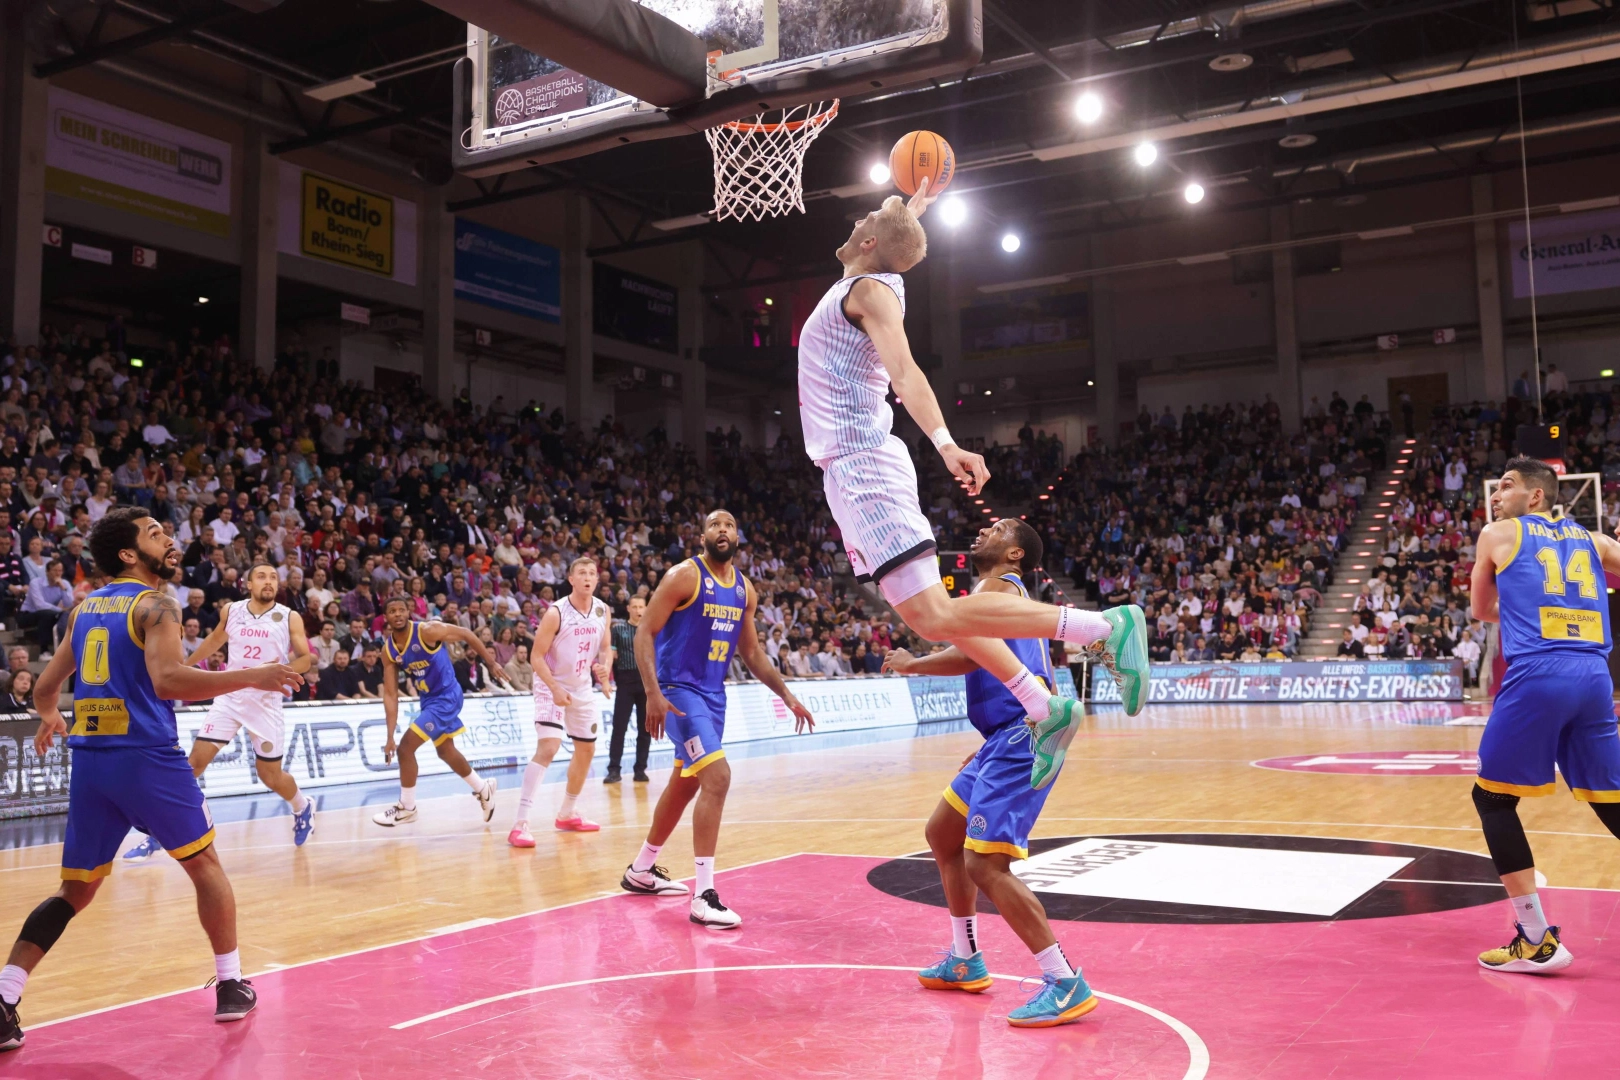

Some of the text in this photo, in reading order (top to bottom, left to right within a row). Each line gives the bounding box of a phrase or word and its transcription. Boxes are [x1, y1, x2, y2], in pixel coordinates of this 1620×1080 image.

[525, 77, 577, 97] BASKETBALL
[525, 83, 584, 106] CHAMPIONS
[525, 100, 560, 115] LEAGUE
[60, 116, 97, 142] MEIN
[101, 129, 178, 166] SCHREINER
[180, 152, 219, 181] WERK
[919, 152, 927, 167] FIBA
[937, 141, 951, 184] Wilson
[316, 186, 382, 226] Radio
[48, 228, 60, 244] C
[327, 217, 370, 242] Bonn/
[134, 248, 145, 265] B
[312, 231, 384, 267] Rhein-Sieg
[1549, 425, 1560, 439] 9
[956, 553, 966, 569] 2
[1535, 546, 1599, 600] 14
[711, 619, 735, 632] bwin
[1546, 612, 1597, 623] PIRAEUS BANK
[240, 628, 269, 638] BONN
[574, 627, 597, 636] BONN
[243, 645, 262, 660] 22
[577, 641, 591, 654] 54
[708, 639, 730, 662] 32
[81, 627, 110, 685] 0
[1261, 665, 1283, 675] DOME
[1321, 665, 1342, 674] ALLE
[1342, 664, 1366, 675] INFOS:
[1095, 677, 1251, 701] BATS-SHUTTLE
[1278, 674, 1452, 699] BASKETS-EXPRESS
[98, 704, 122, 712] BANK
